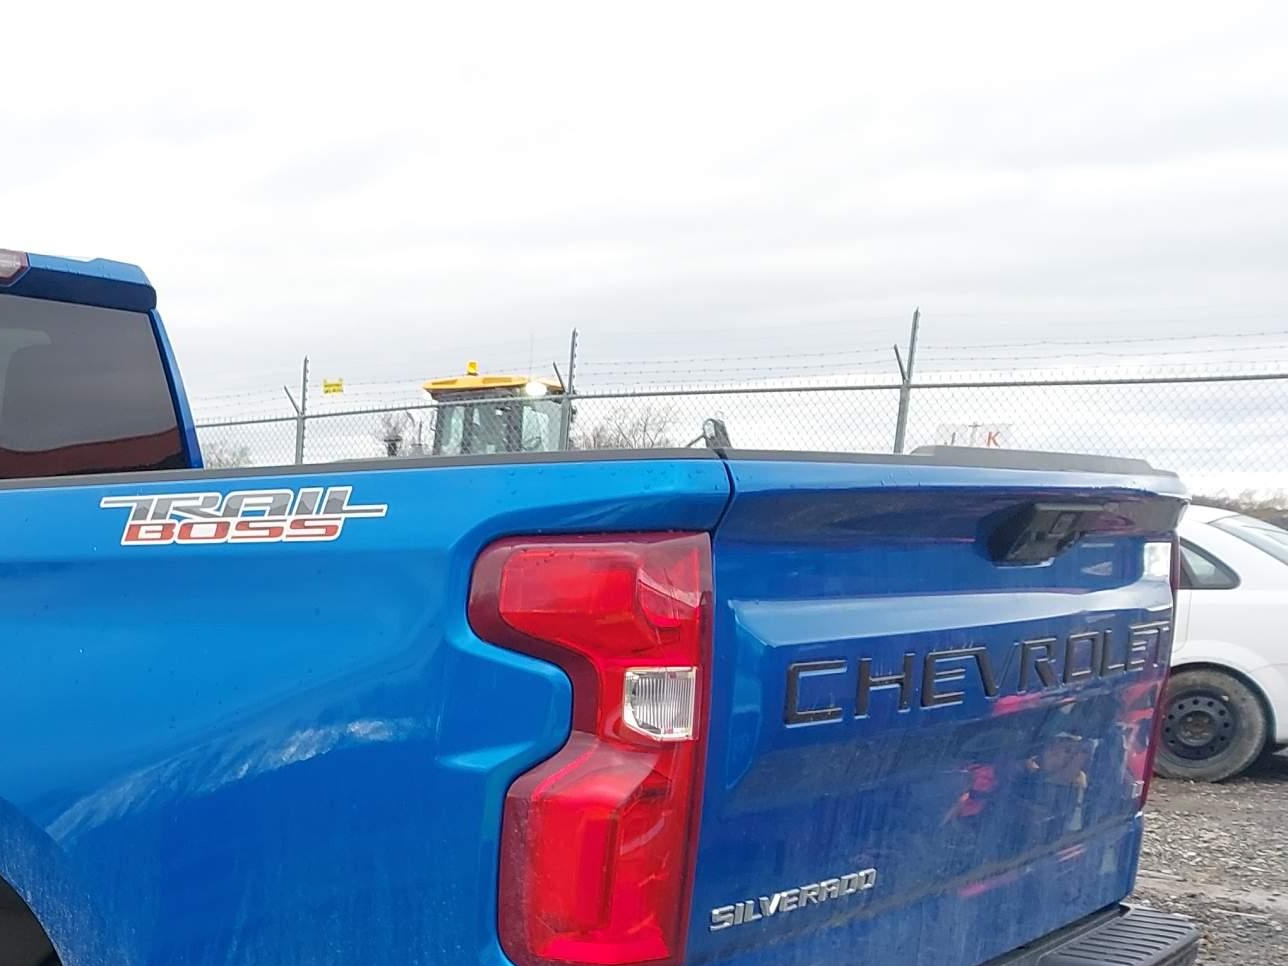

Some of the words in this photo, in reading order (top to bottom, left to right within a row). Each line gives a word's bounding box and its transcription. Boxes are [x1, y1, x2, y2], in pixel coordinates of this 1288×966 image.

[100, 486, 388, 521] TRAIL
[121, 517, 344, 546] BOSS
[784, 621, 1171, 729] CHEVROLET
[709, 867, 876, 932] SILVERADO
